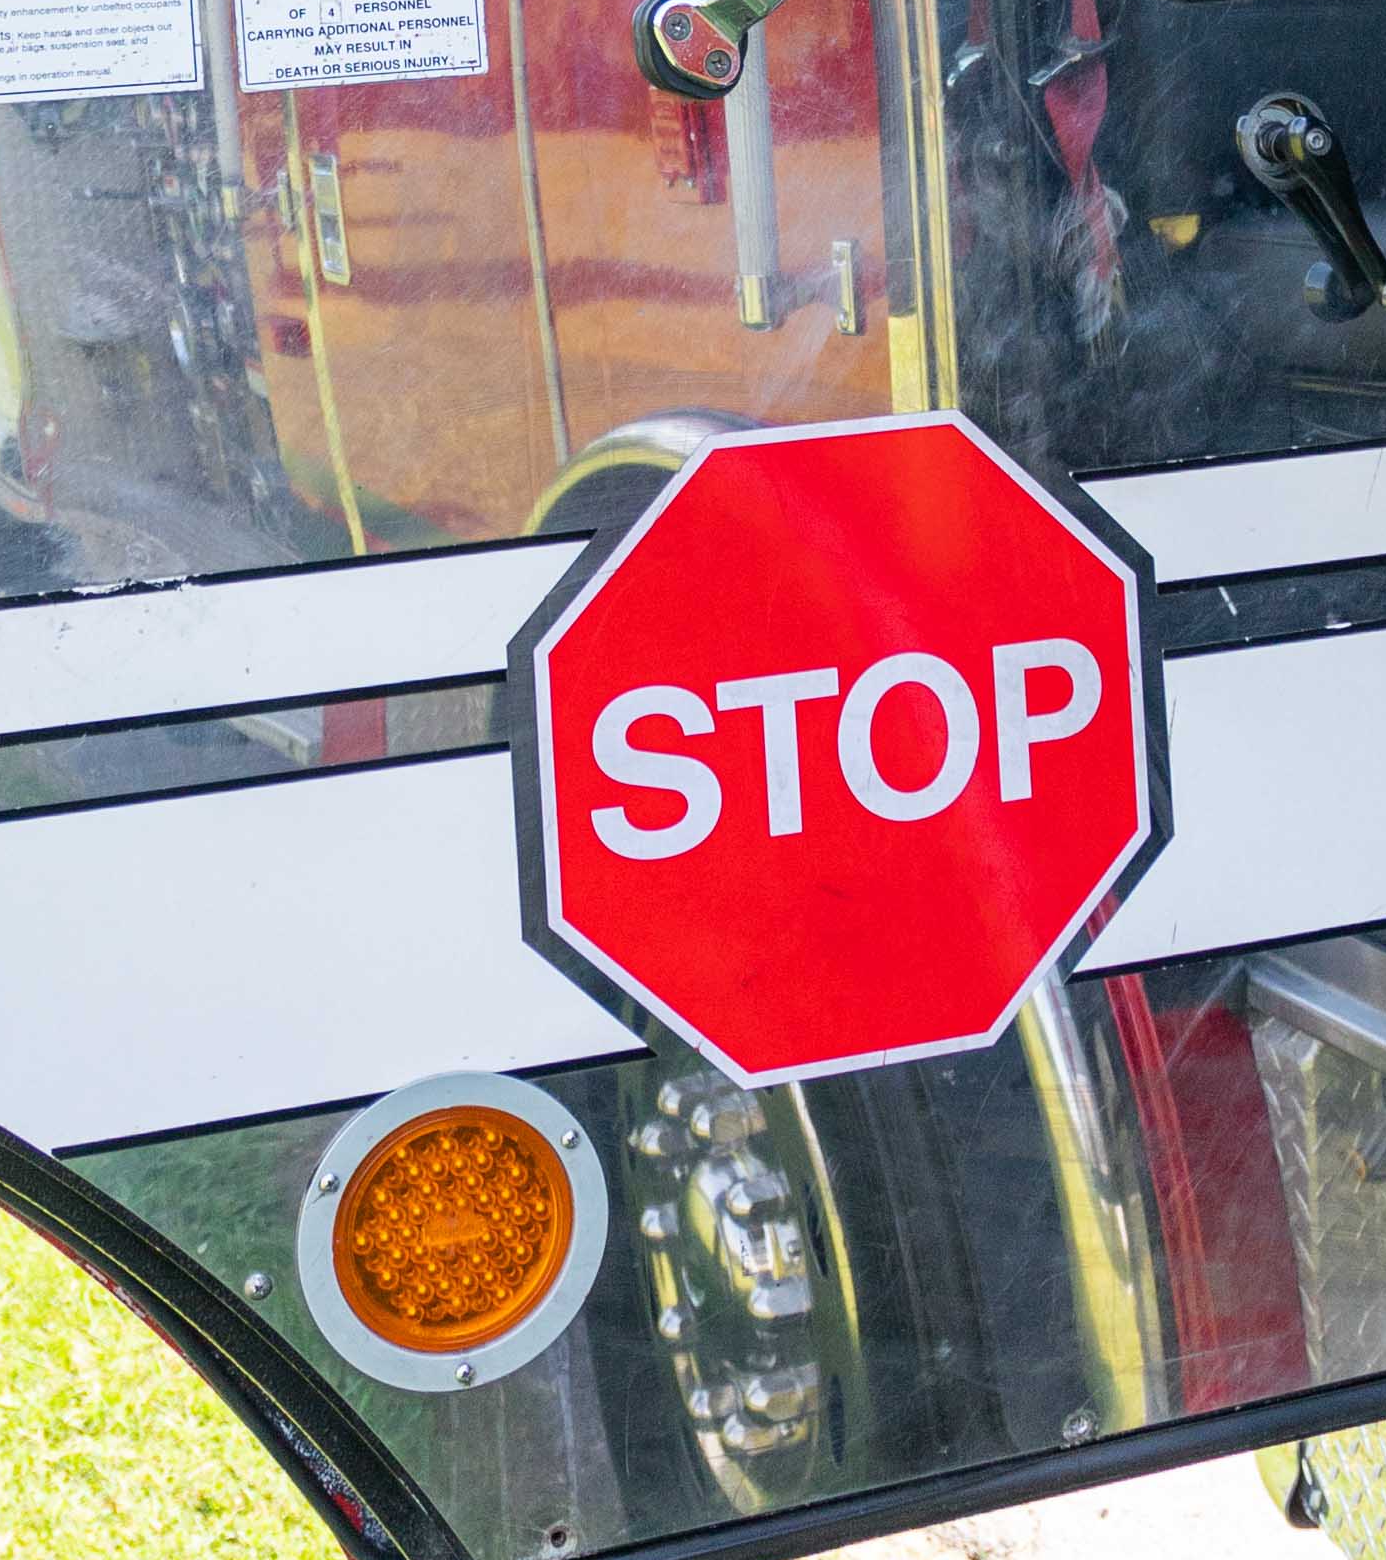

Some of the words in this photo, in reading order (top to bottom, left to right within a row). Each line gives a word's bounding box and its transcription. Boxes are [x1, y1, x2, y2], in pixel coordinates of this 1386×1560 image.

[289, 8, 306, 20] OF
[328, 7, 335, 17] 4
[354, 0, 432, 14] PERSONNEL
[247, 26, 314, 41] CARRYING
[318, 21, 395, 37] ADDITIONAL
[398, 15, 474, 29] PERSONNEL
[314, 43, 341, 55] MAY
[346, 40, 395, 52] RESULT
[399, 39, 411, 49] IN
[275, 65, 318, 78] DEATH
[322, 63, 341, 74] OR
[344, 59, 400, 72] SERIOUS
[591, 637, 1103, 861] STOP
